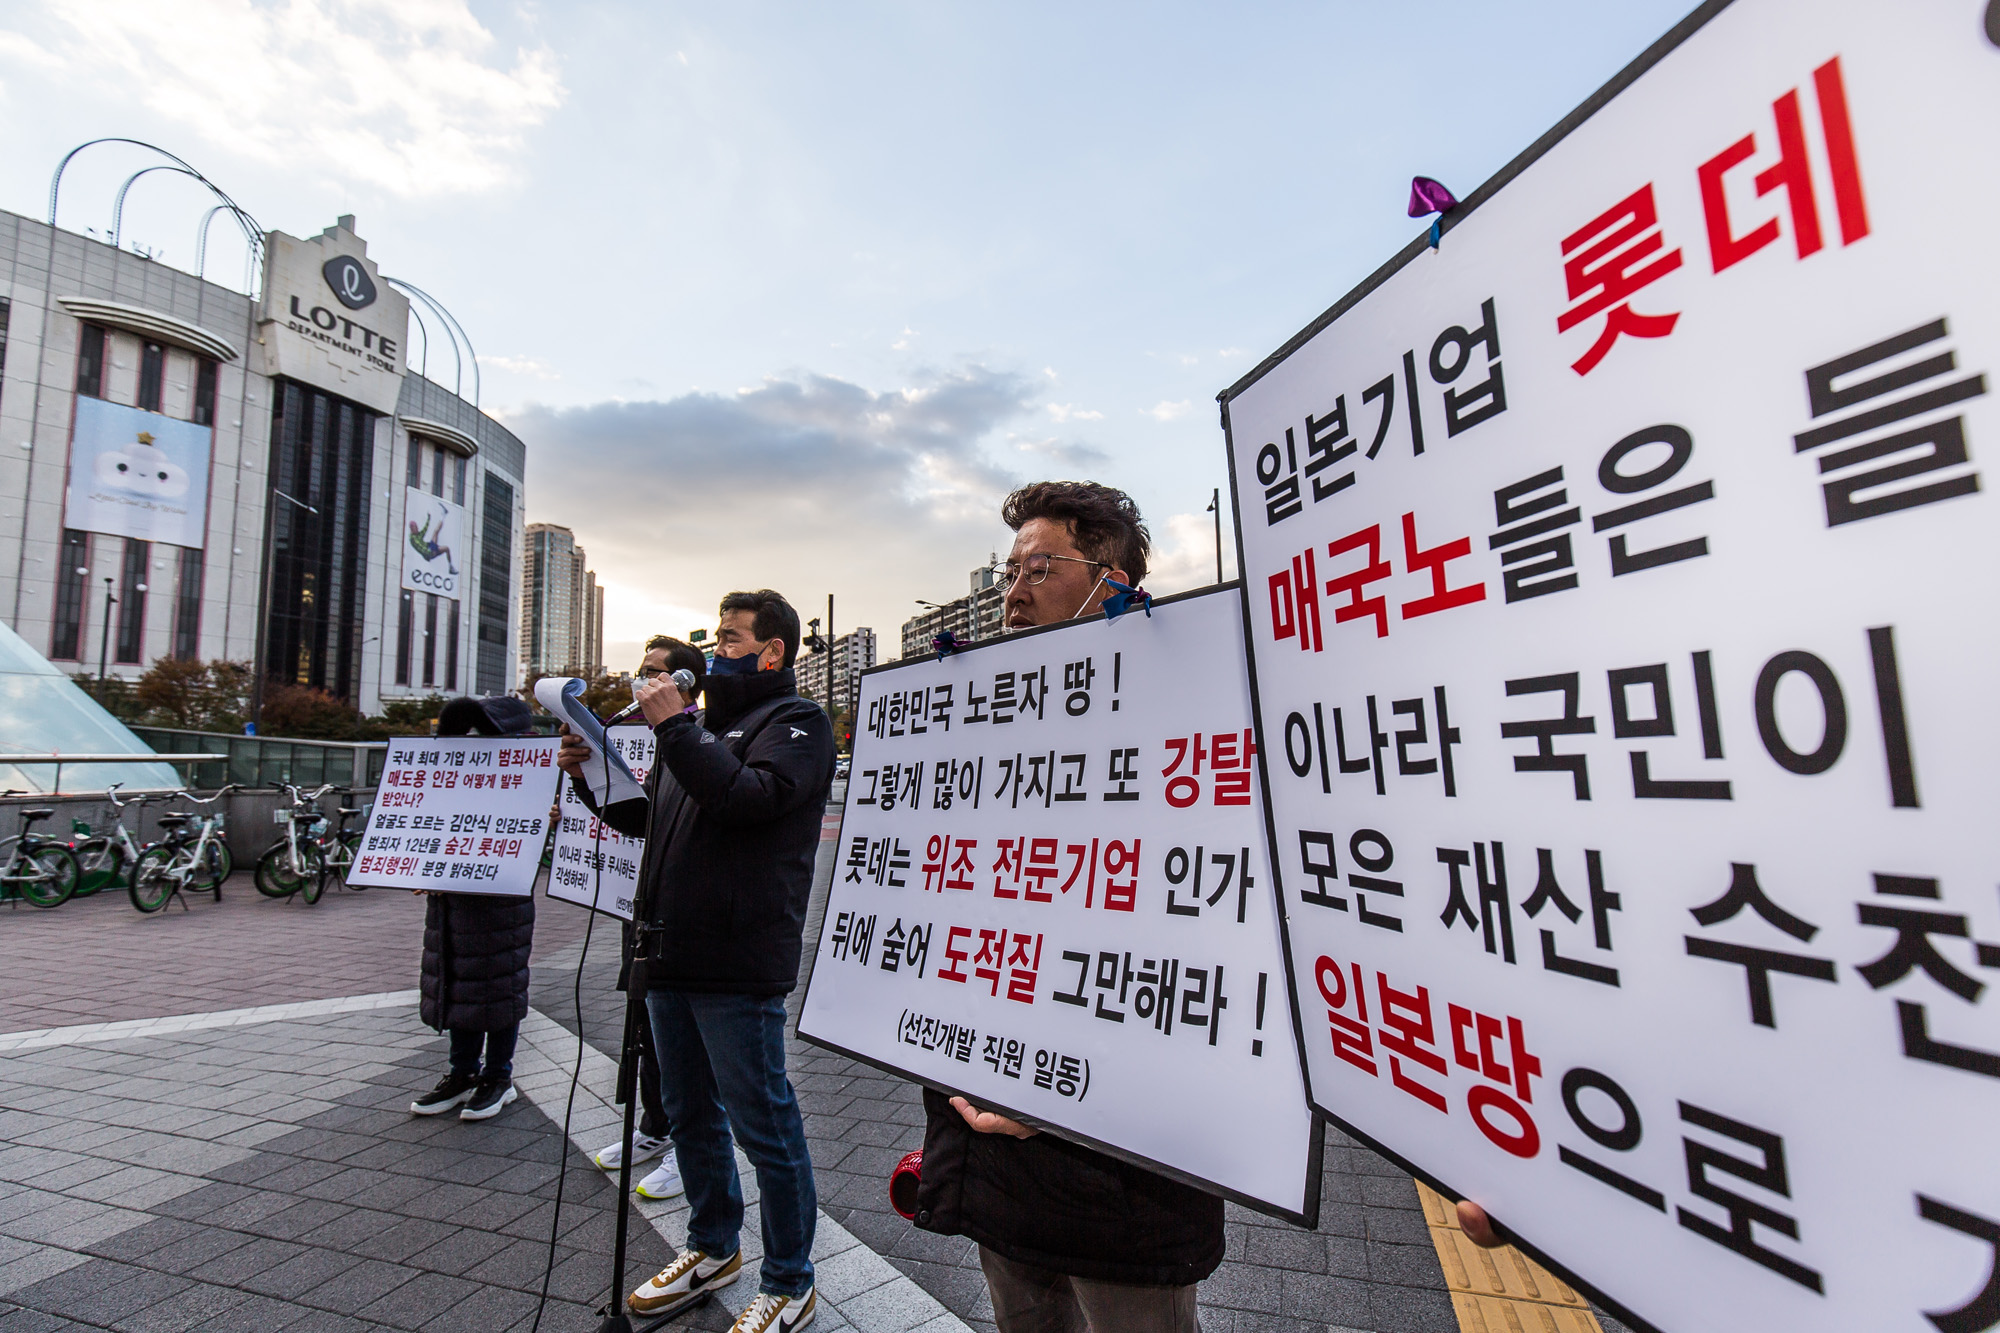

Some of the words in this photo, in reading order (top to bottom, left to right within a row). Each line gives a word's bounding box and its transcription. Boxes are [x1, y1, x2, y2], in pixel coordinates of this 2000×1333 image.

[1255, 296, 1508, 528] 일본기업
[1557, 53, 1872, 377] 롯데
[289, 320, 363, 358] DEPARTMENT
[366, 353, 396, 373] STORE
[290, 294, 397, 361] LOTTE
[1267, 422, 1716, 653] 매국노들은
[1791, 315, 1989, 529] 들
[411, 569, 453, 591] ecco
[867, 682, 954, 739] 대한민국
[963, 665, 1048, 726] 노른자
[1063, 656, 1095, 717] 땅
[1284, 685, 1462, 798] 이나라
[1500, 624, 1924, 810] 국민이
[387, 769, 427, 788] 매도용
[432, 770, 459, 789] 인감
[462, 774, 496, 789] 어떻게
[500, 774, 523, 789] 발부
[392, 751, 414, 766] 국내
[417, 751, 440, 766] 최대
[443, 751, 465, 766] 기업
[469, 751, 492, 766] 사기
[498, 748, 553, 768] 범죄사실
[856, 760, 924, 812] 그렇게
[933, 756, 985, 811] 많이
[993, 750, 1088, 809] 가지고
[1103, 746, 1140, 802] 또
[1161, 728, 1257, 809] 강탈
[375, 814, 408, 829] 얼굴도
[410, 815, 445, 831] 모르는
[450, 814, 491, 833] 김안식
[495, 817, 542, 835] 인감도용
[381, 792, 424, 808] 받았나?
[562, 816, 586, 836] 범죄자
[359, 856, 419, 876] 범죄행위!
[421, 861, 447, 878] 분명
[450, 862, 499, 881] 밝혀진다
[367, 836, 401, 852] 범죄자
[405, 838, 441, 854] 12년을
[444, 836, 475, 856] 숨긴
[478, 837, 523, 859] 롯데의
[559, 845, 582, 865] 이나라
[607, 855, 636, 880] 무시하는
[555, 867, 589, 891] 각성하라!
[844, 835, 912, 889] 롯데는
[920, 833, 977, 894] 위조
[992, 836, 1141, 913] 전문기업
[1163, 845, 1255, 924] 인가
[1298, 827, 1405, 934] 모은
[1435, 839, 1623, 989] 재산
[831, 911, 877, 966] 뒤에
[882, 917, 933, 979] 숨어
[937, 926, 1044, 1005] 도적질
[1052, 949, 1227, 1047] 그만해라
[897, 1008, 977, 1064] (선진개발
[982, 1034, 1026, 1081] 직원
[1033, 1047, 1091, 1102] 일동)
[1313, 953, 1827, 1297] 일본땅으로
